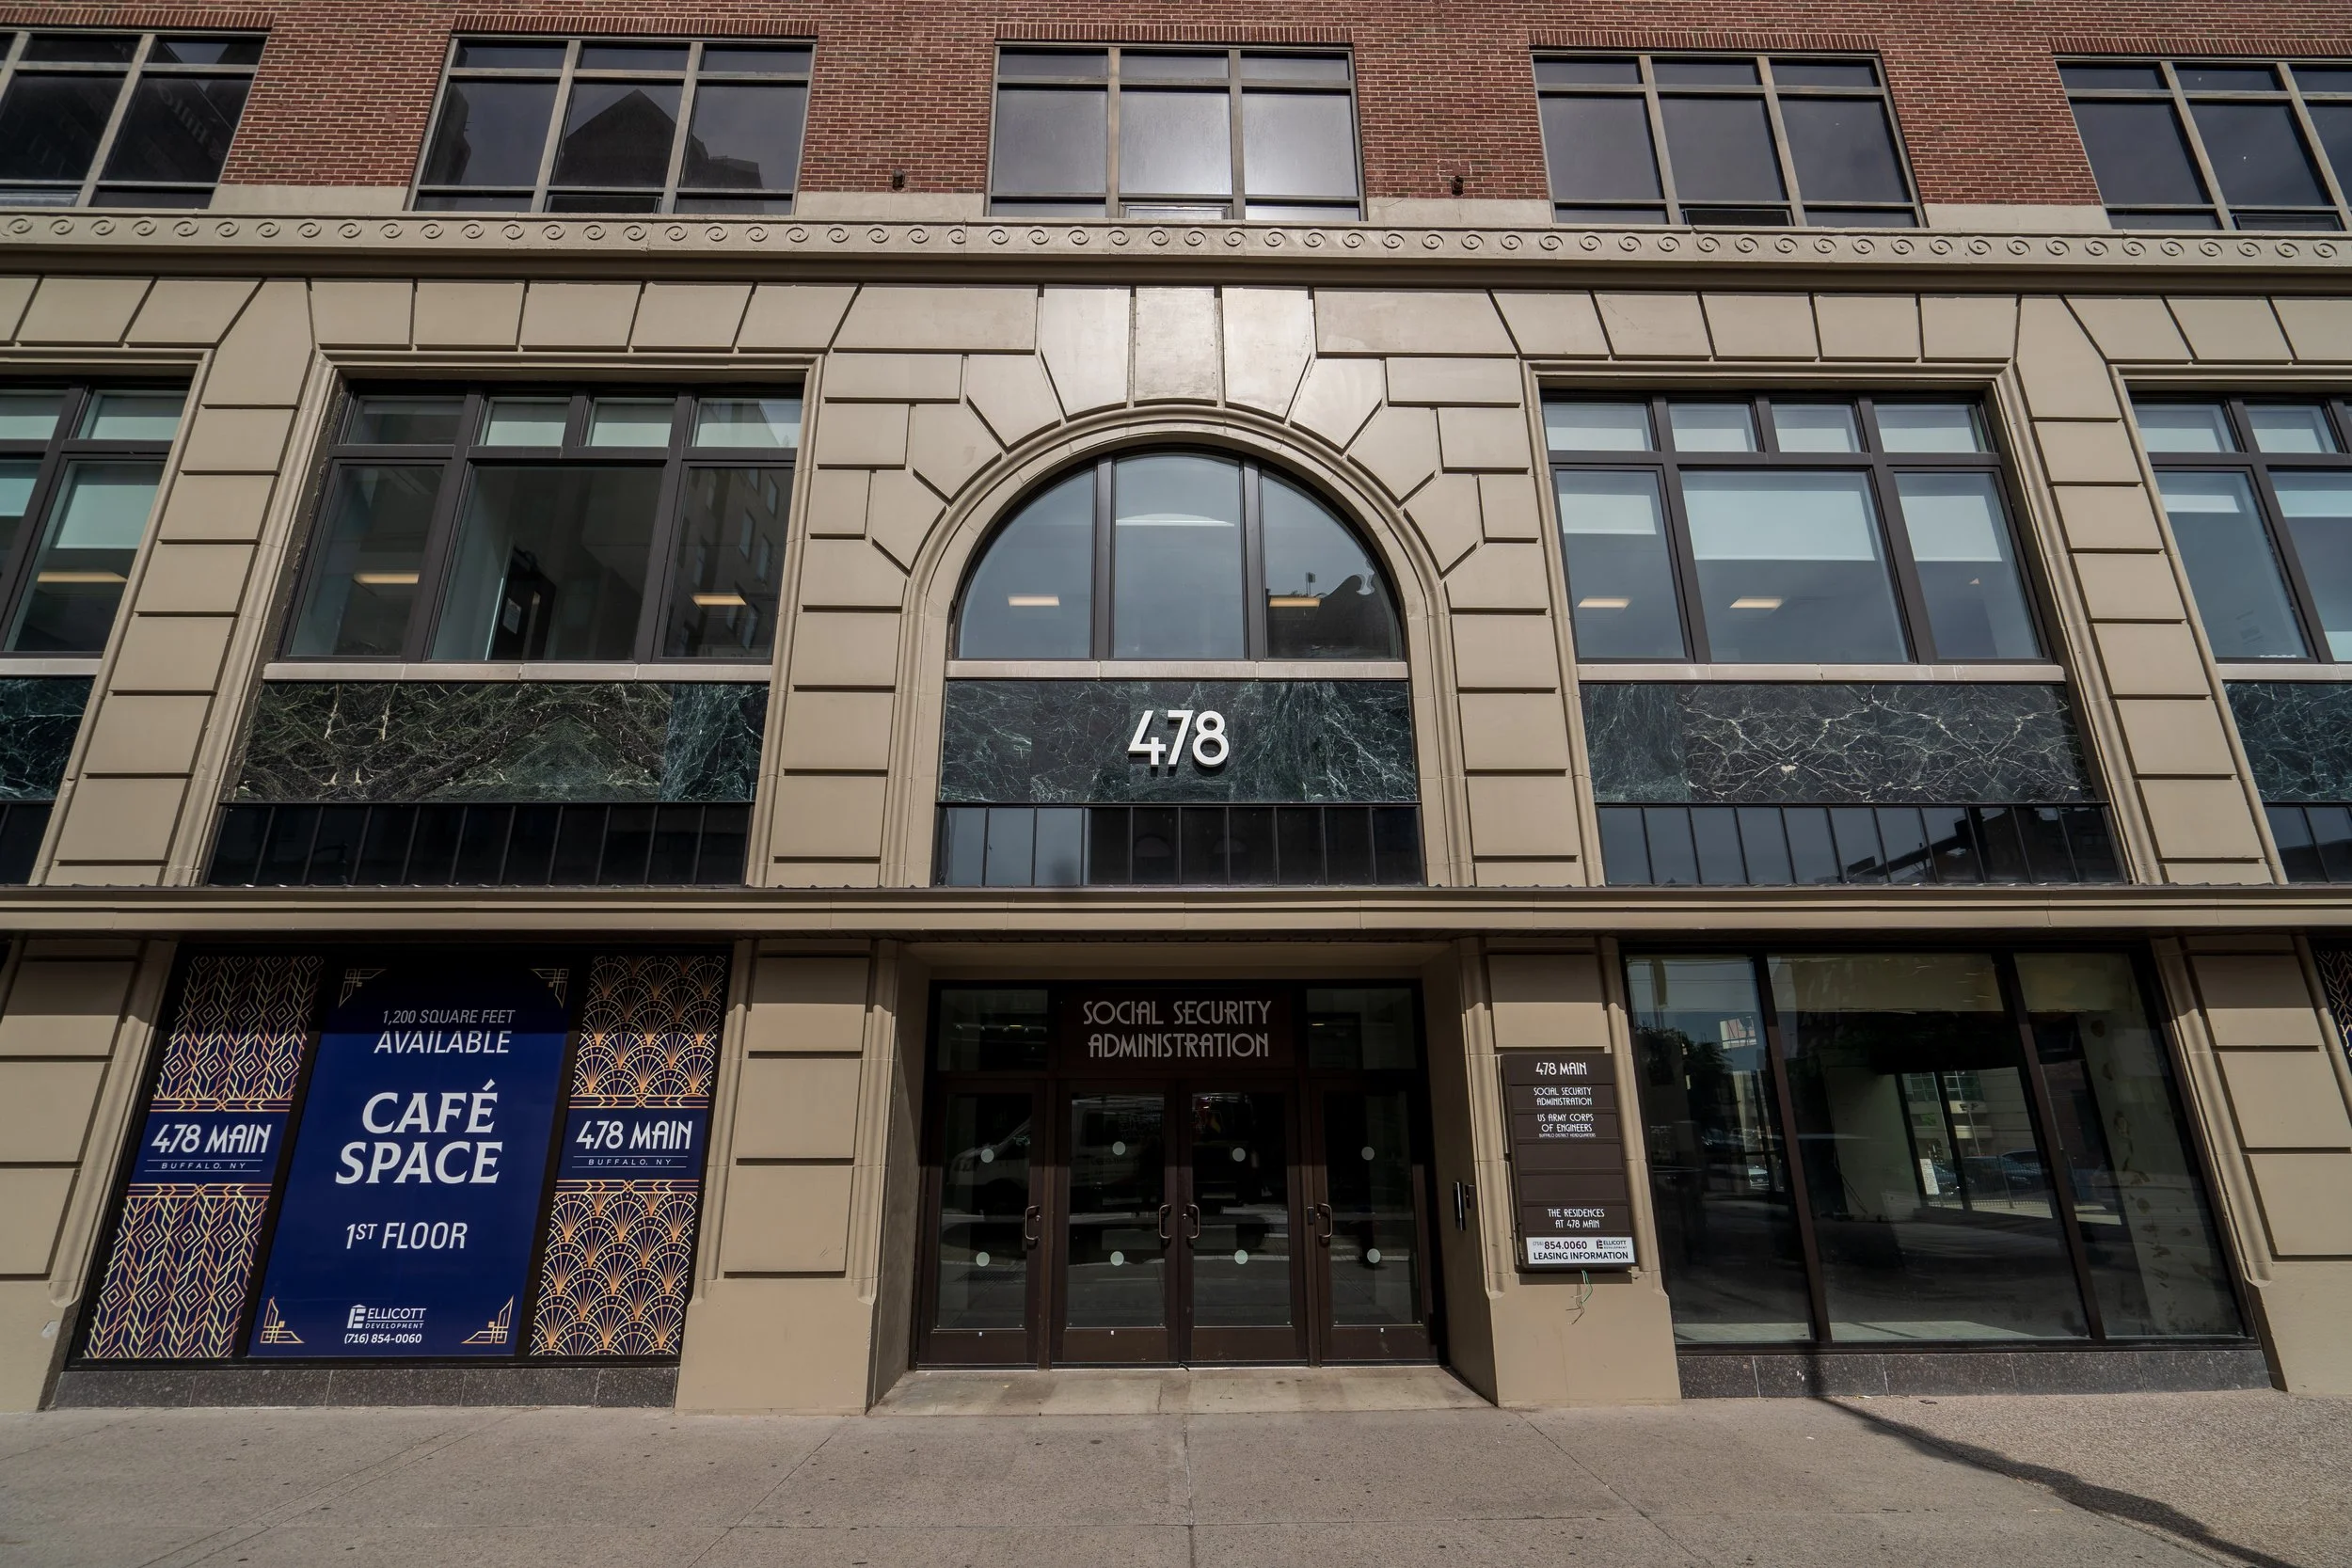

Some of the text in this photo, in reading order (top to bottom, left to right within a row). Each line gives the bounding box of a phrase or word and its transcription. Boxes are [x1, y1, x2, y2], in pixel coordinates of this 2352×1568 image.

[1127, 709, 1230, 767] 478
[383, 1009, 516, 1025] 1,200 SQUARE FEET
[1083, 1000, 1272, 1025] SOCIAL SECURITY
[373, 1030, 512, 1053] AVAILABLE
[1088, 1033, 1269, 1058] ADMINISTRATION
[1535, 1062, 1588, 1075] 478 MAIN
[1534, 1086, 1592, 1096] SOCIAL SECURITY
[361, 1078, 499, 1134] CAFÉ
[1536, 1097, 1593, 1106] ADMINISTRATION
[1536, 1113, 1595, 1122] US ARMY CORPS
[1541, 1123, 1593, 1132] OF ENGINEERS
[151, 1123, 272, 1153] 478 MAIN
[575, 1120, 693, 1149] 478 MAIN
[335, 1140, 503, 1185] SPACE
[1548, 1208, 1605, 1217] THE RESIDENCES
[1555, 1219, 1600, 1228] AT 478 MAIN
[346, 1222, 469, 1250] 1ST FLOOR
[1544, 1241, 1587, 1250] 854.0060
[1534, 1251, 1629, 1260] LEASING INFORMATION
[367, 1307, 427, 1320] ELLICOTT
[344, 1333, 422, 1344] (716) 854-0060
